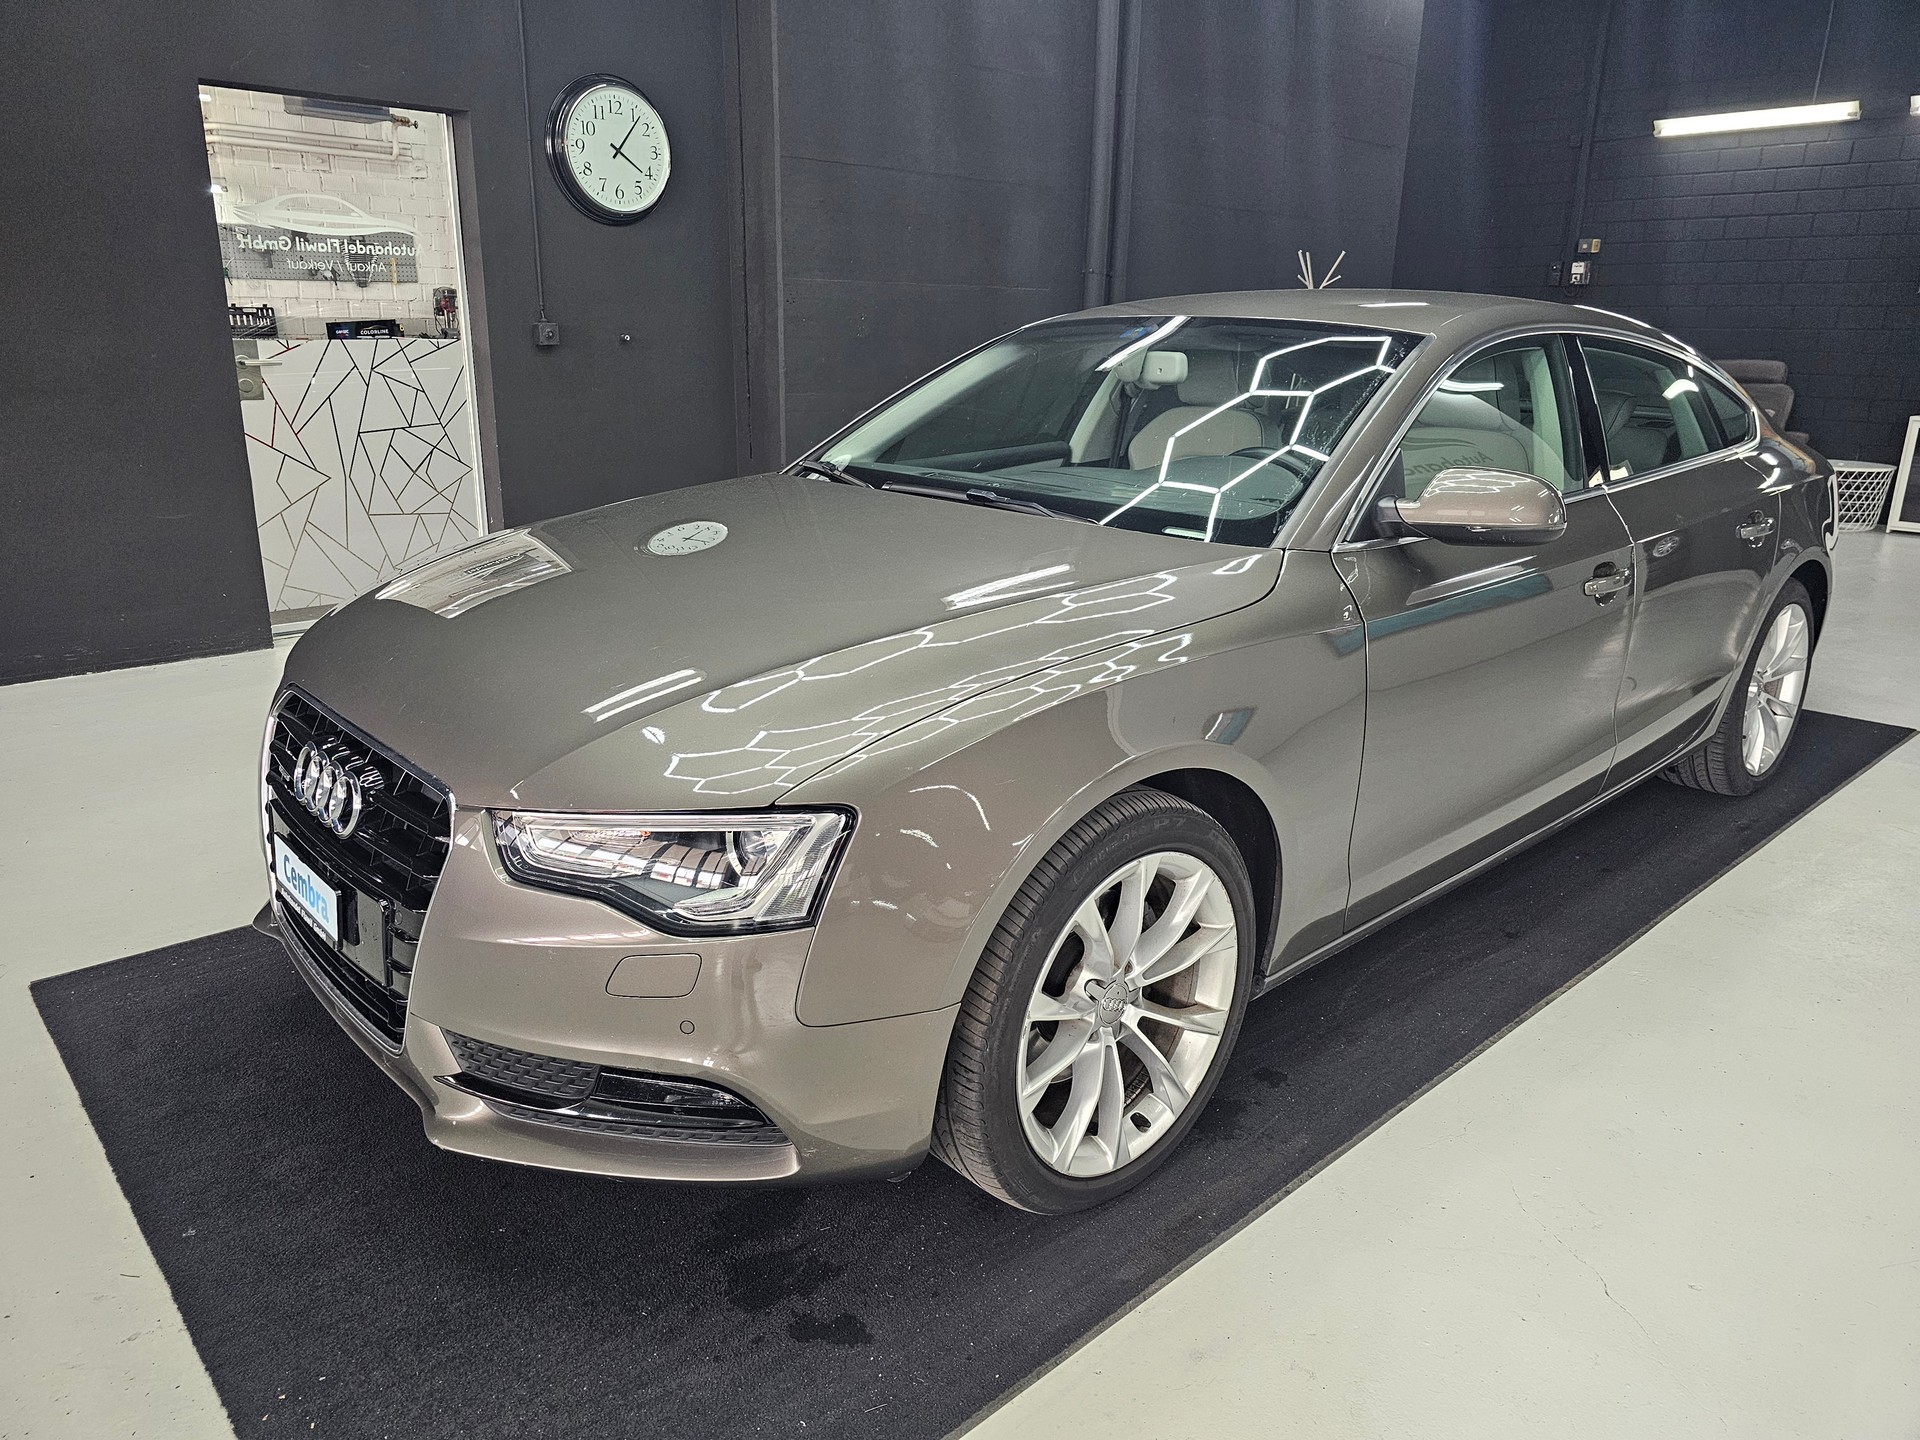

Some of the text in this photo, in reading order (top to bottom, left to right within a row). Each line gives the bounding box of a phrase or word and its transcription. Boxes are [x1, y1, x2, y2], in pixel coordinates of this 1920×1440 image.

[592, 104, 606, 120] 11
[608, 100, 623, 115] 12
[630, 107, 636, 122] 1
[580, 120, 596, 136] 10
[641, 122, 650, 137] 2
[575, 138, 585, 154] 9
[650, 146, 658, 160] 3
[582, 161, 593, 176] 8
[644, 166, 653, 180] 4
[599, 177, 607, 192] 7
[615, 183, 625, 200] 6
[634, 180, 643, 195] 5
[283, 854, 330, 924] Cembra
